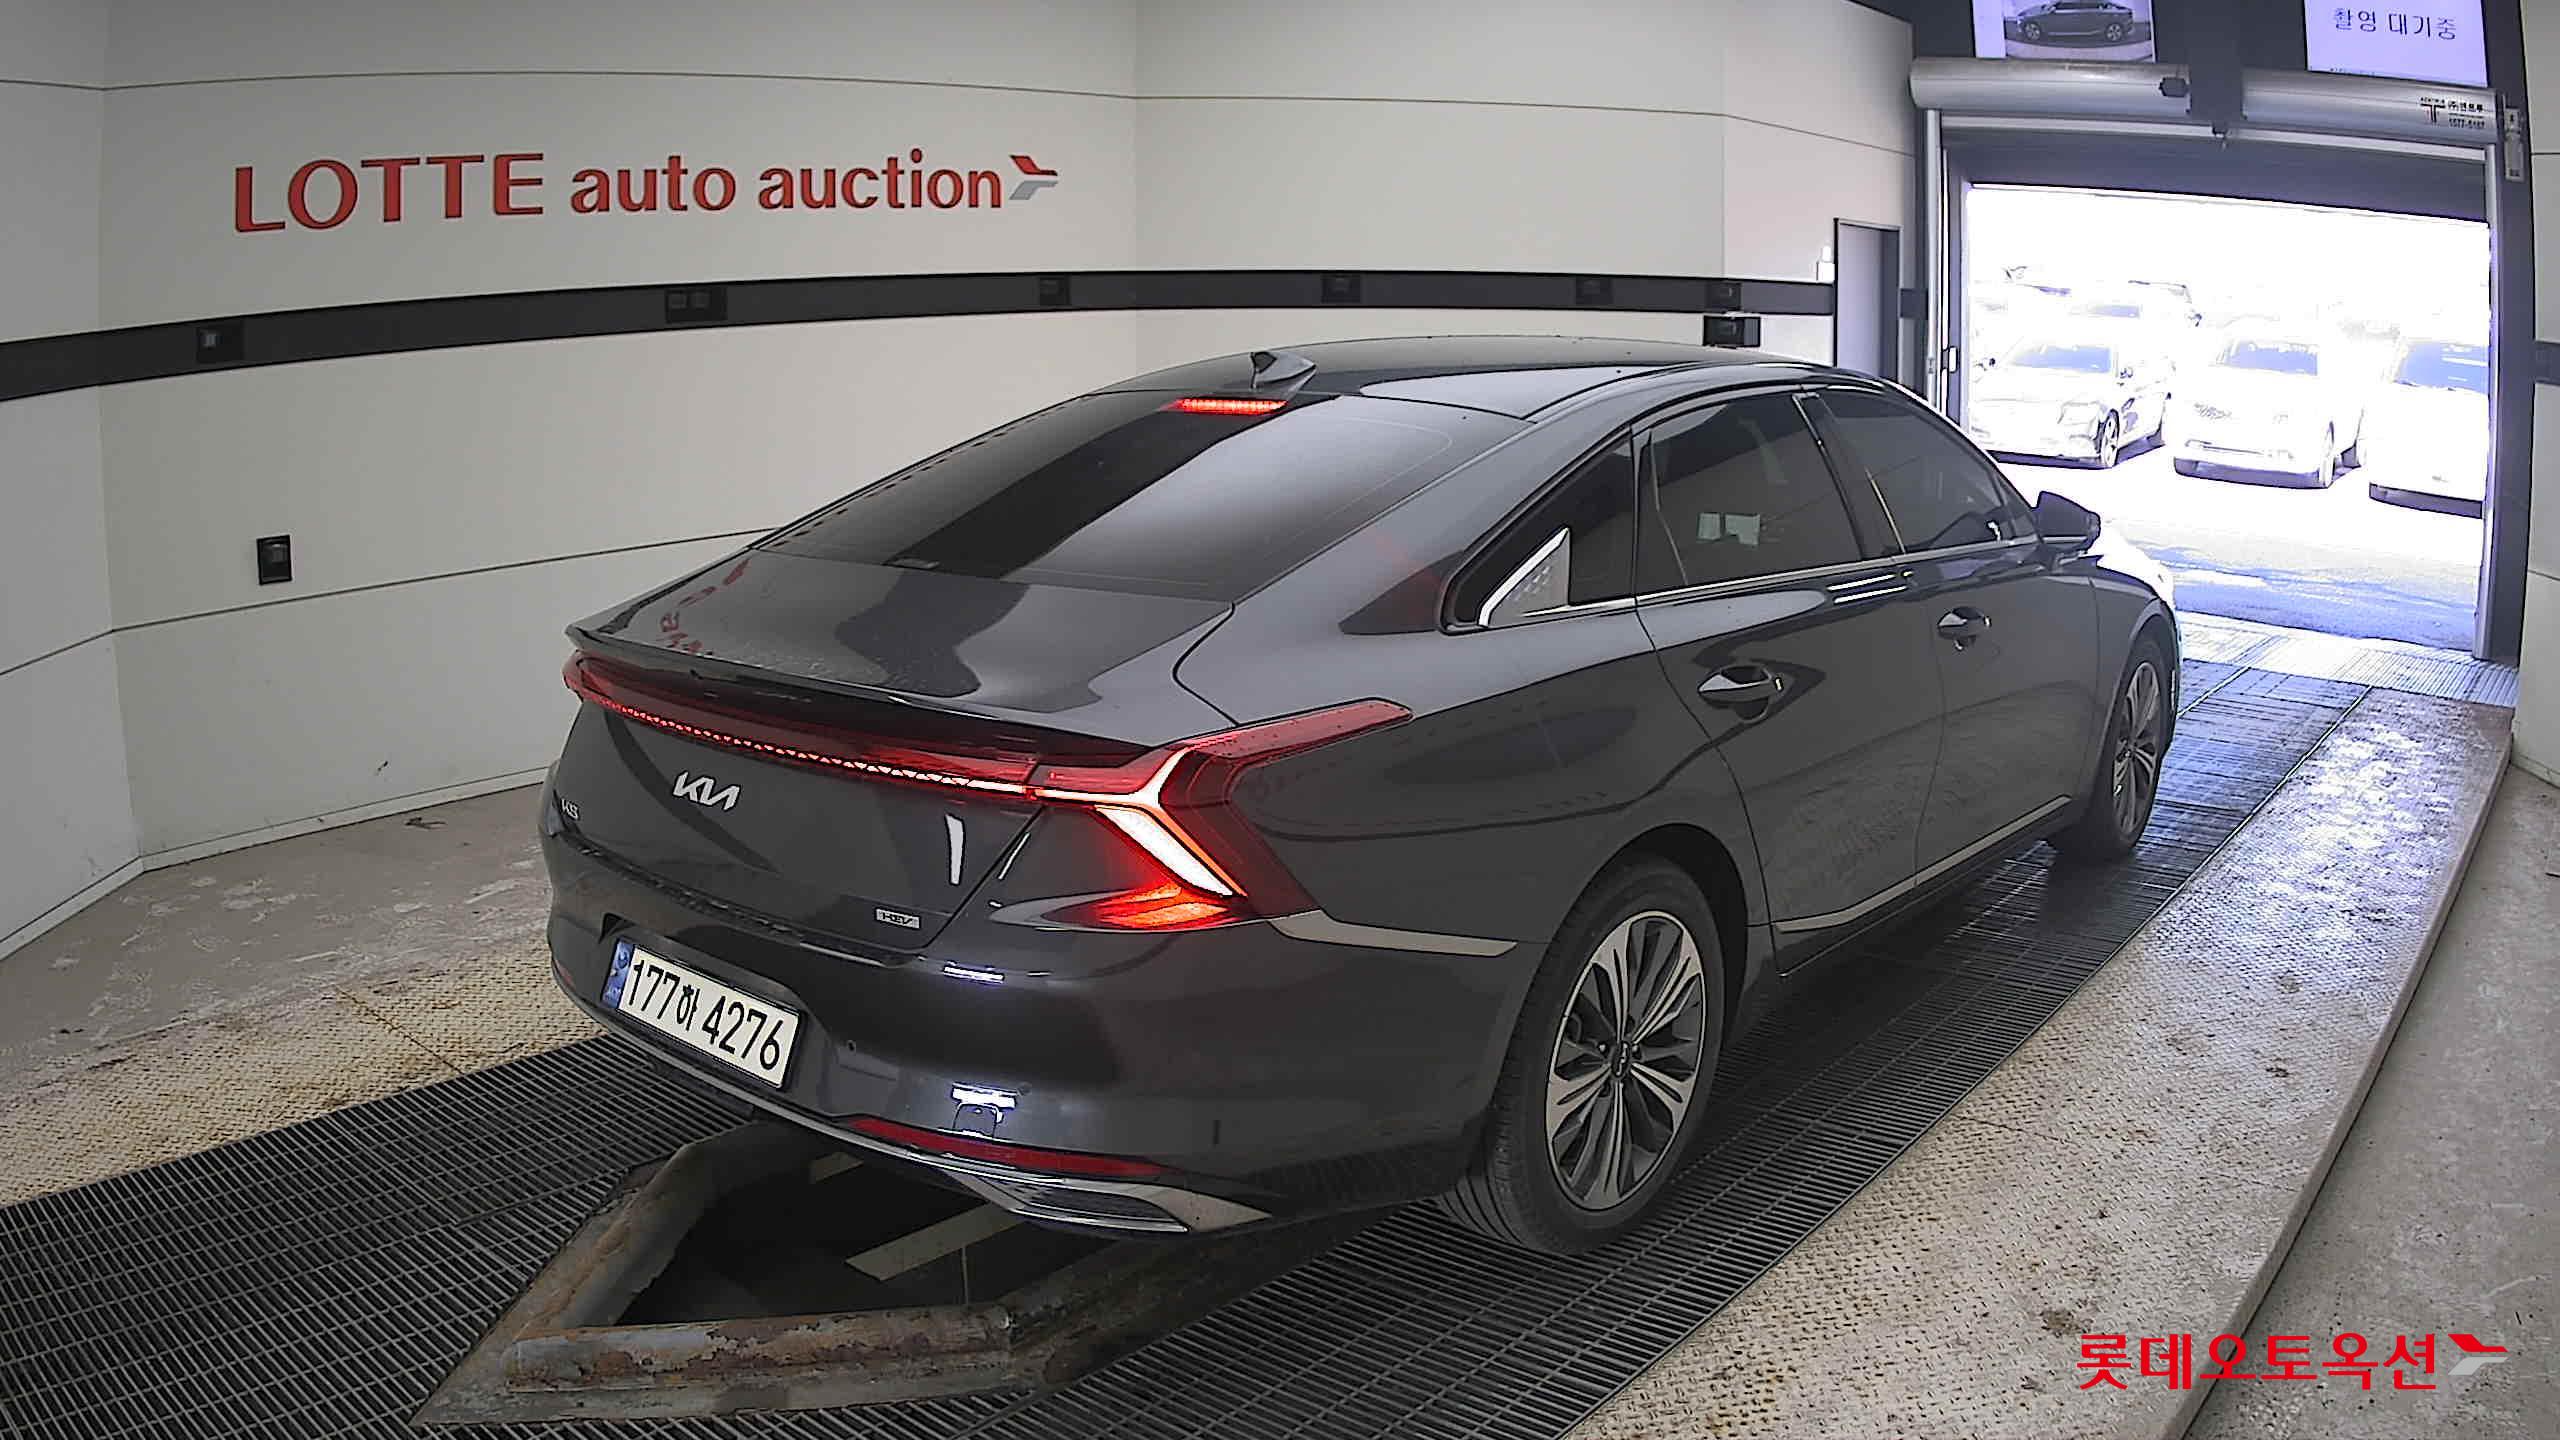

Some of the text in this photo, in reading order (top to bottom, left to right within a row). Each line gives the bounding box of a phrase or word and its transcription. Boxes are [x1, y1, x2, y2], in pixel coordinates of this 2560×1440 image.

[2388, 13, 2457, 41] 대기중
[235, 148, 1002, 233] LOTTE auto auction
[628, 959, 785, 1071] 177하 4276
